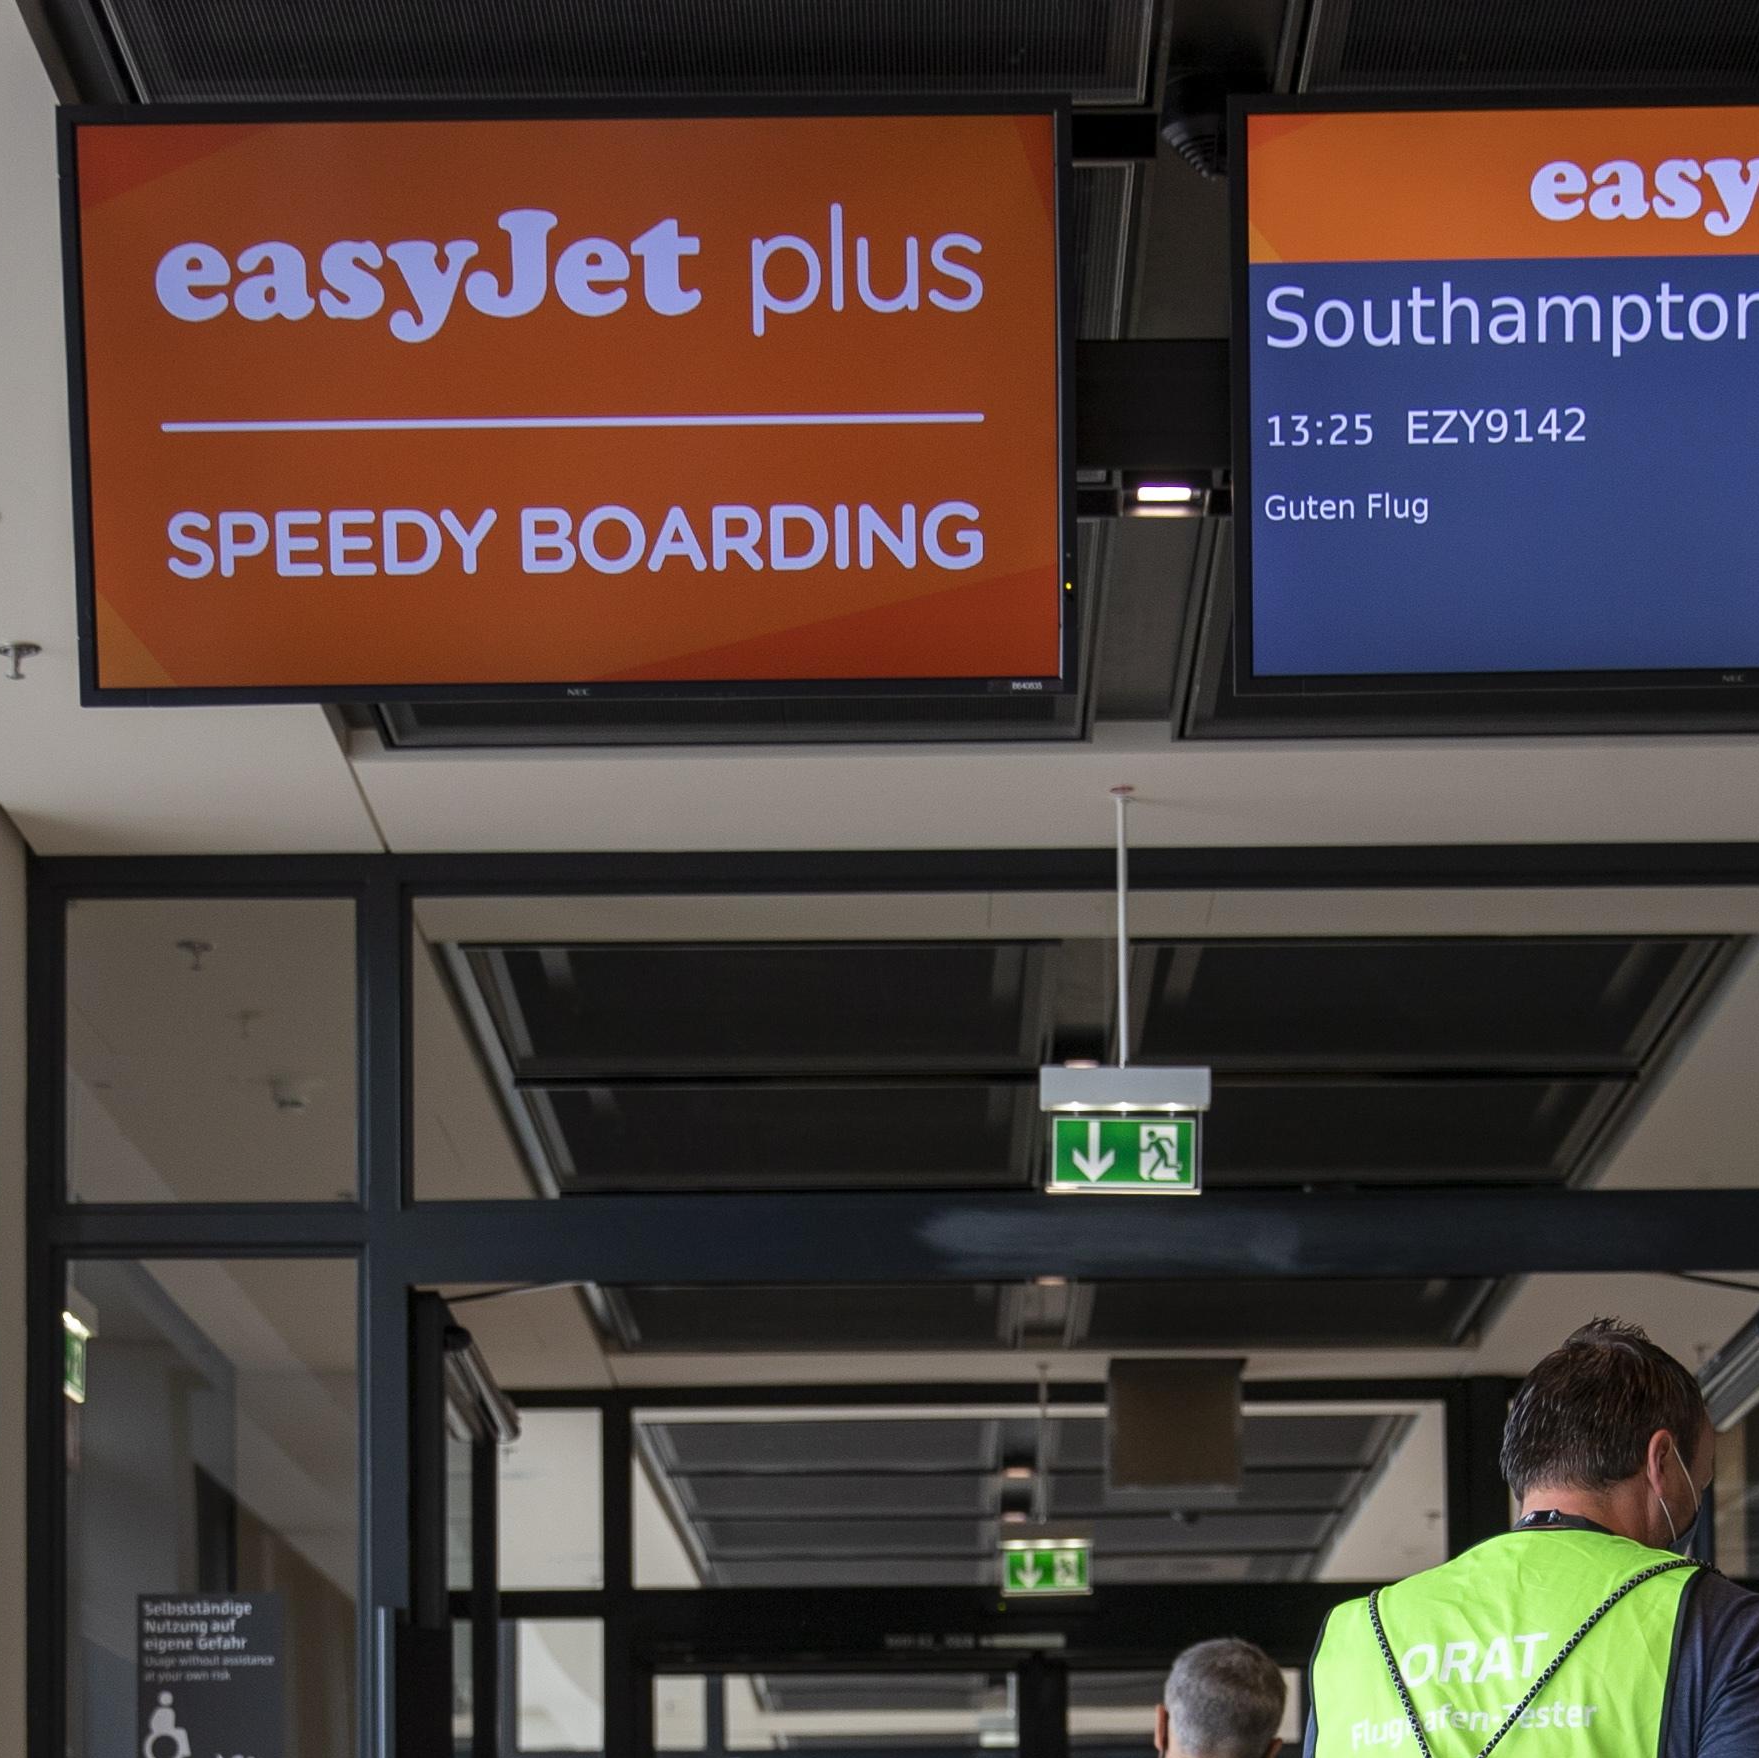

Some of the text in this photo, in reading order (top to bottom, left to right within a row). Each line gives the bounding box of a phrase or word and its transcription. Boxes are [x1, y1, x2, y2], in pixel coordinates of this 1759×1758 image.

[154, 202, 984, 343] easyJet plus
[1266, 407, 1587, 447] 13:25 EZY9142
[1264, 492, 1429, 524] Guten Flug
[167, 500, 984, 580] SPEEDY BOARDING
[144, 1600, 252, 1619] Selbstständige
[144, 1618, 236, 1637] Nutzung auf
[144, 1635, 248, 1653] eigene Gefahr
[179, 1655, 220, 1666] without
[222, 1655, 275, 1666] assistance
[1401, 1632, 1549, 1688] ORAT
[158, 1671, 182, 1683] your
[185, 1672, 209, 1681] own
[211, 1669, 231, 1681] risk
